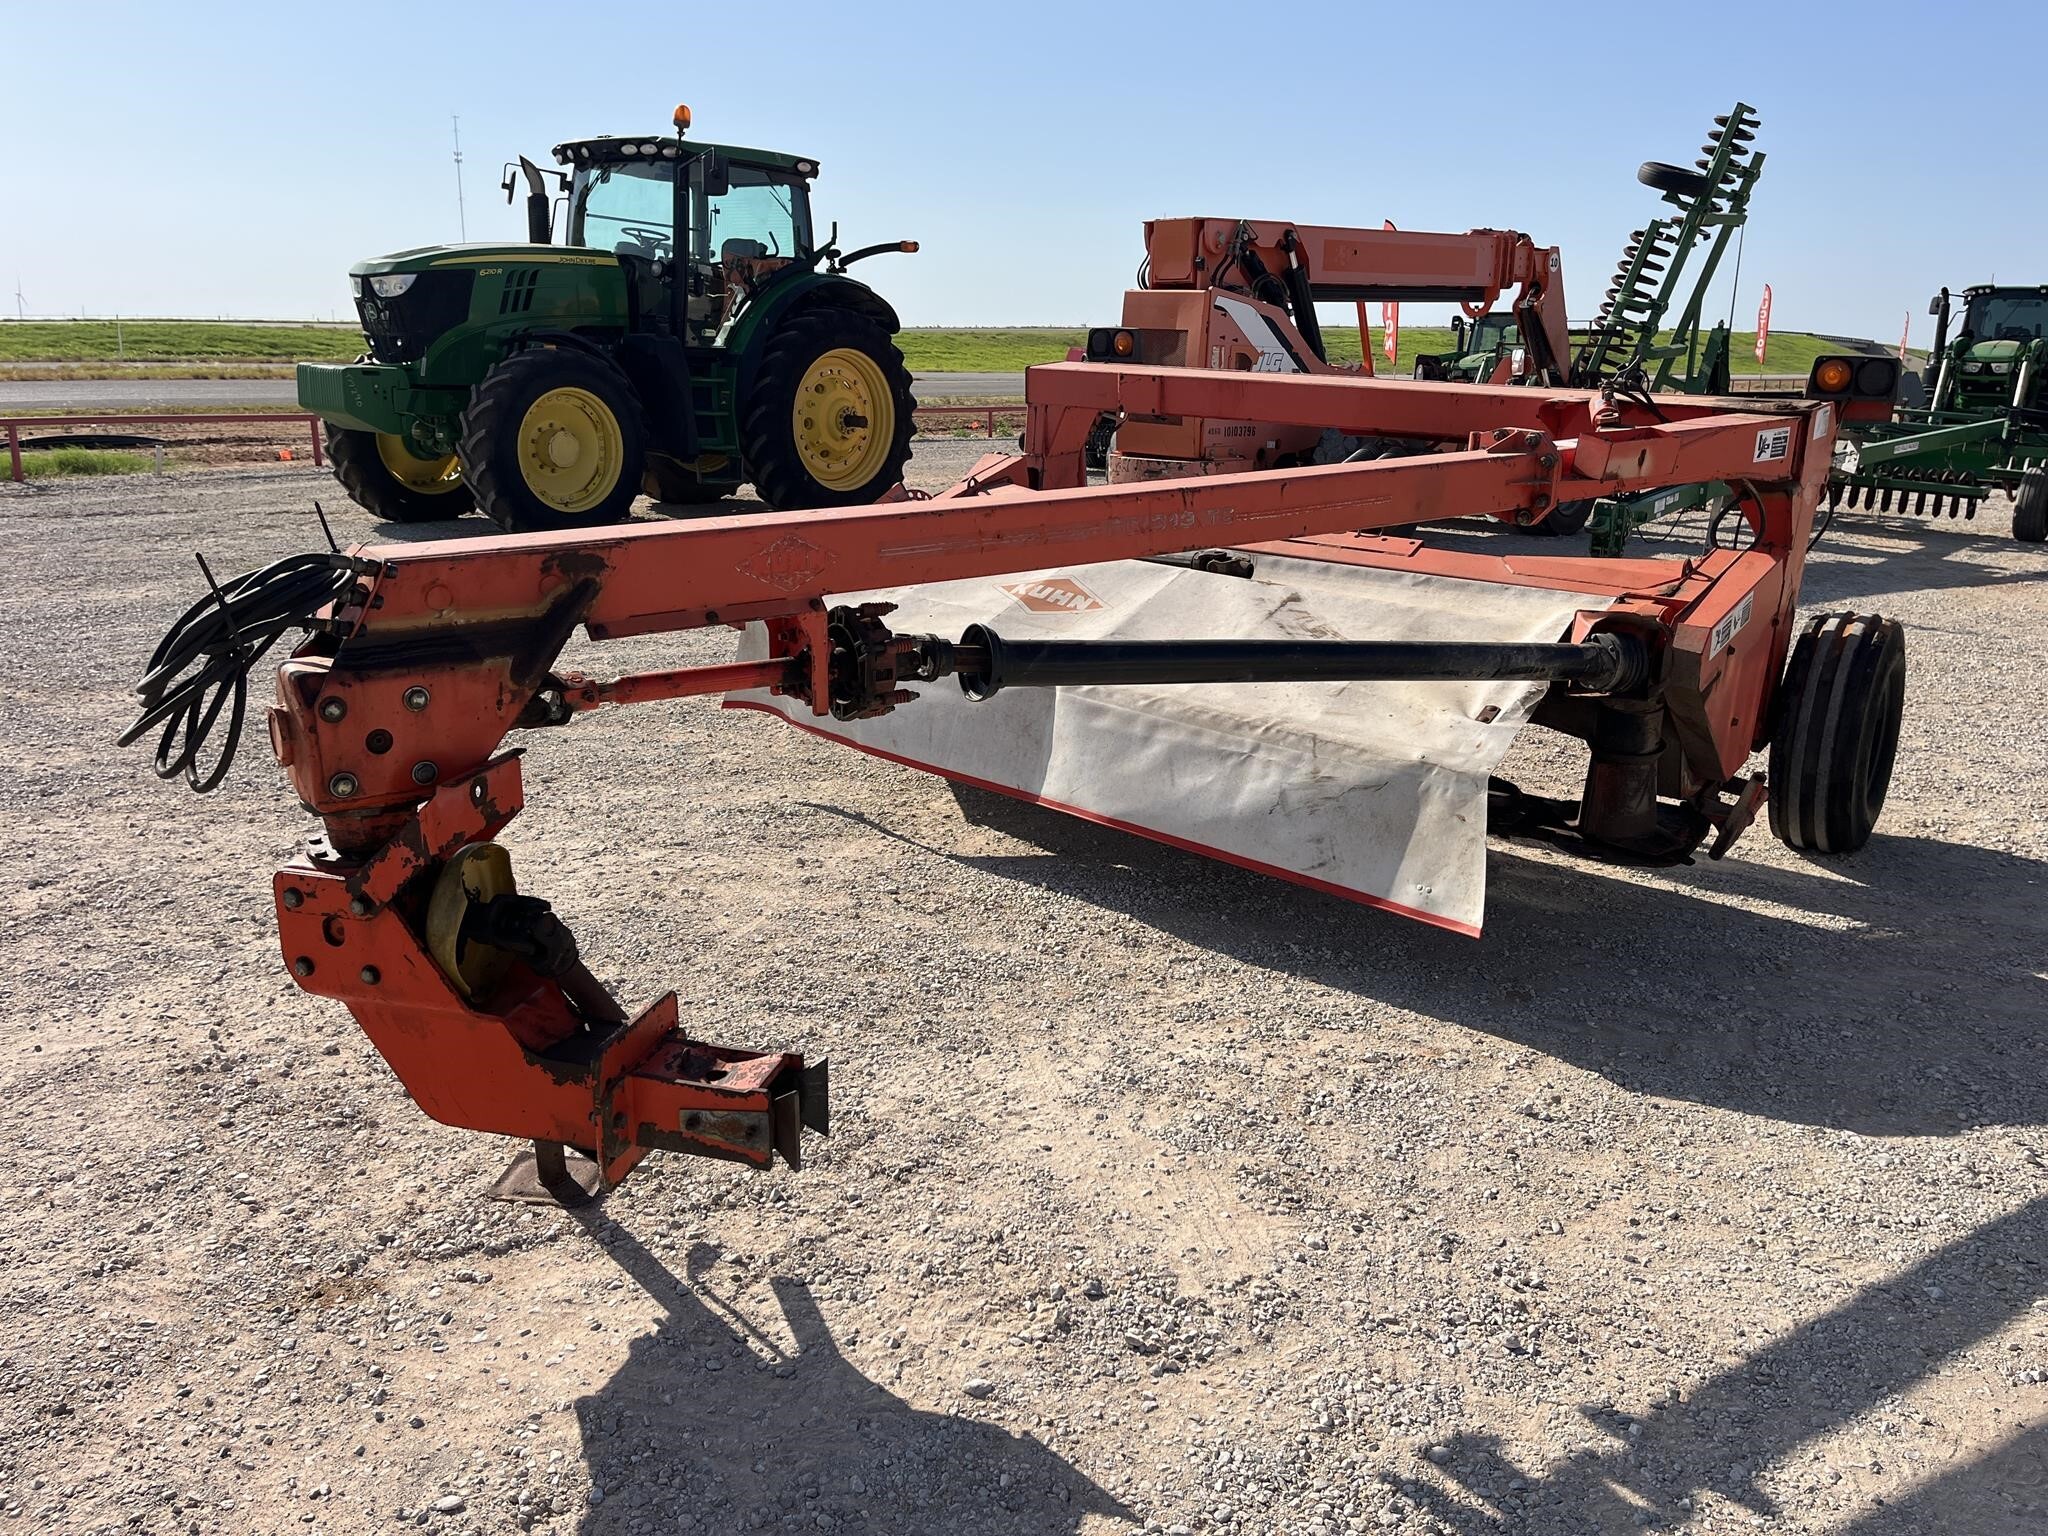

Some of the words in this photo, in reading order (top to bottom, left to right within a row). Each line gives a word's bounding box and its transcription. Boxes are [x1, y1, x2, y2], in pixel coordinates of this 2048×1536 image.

[576, 257, 596, 265] DEERE
[1551, 257, 1558, 268] 10
[1224, 426, 1256, 437] 10103796
[1009, 583, 1095, 610] KUHN
